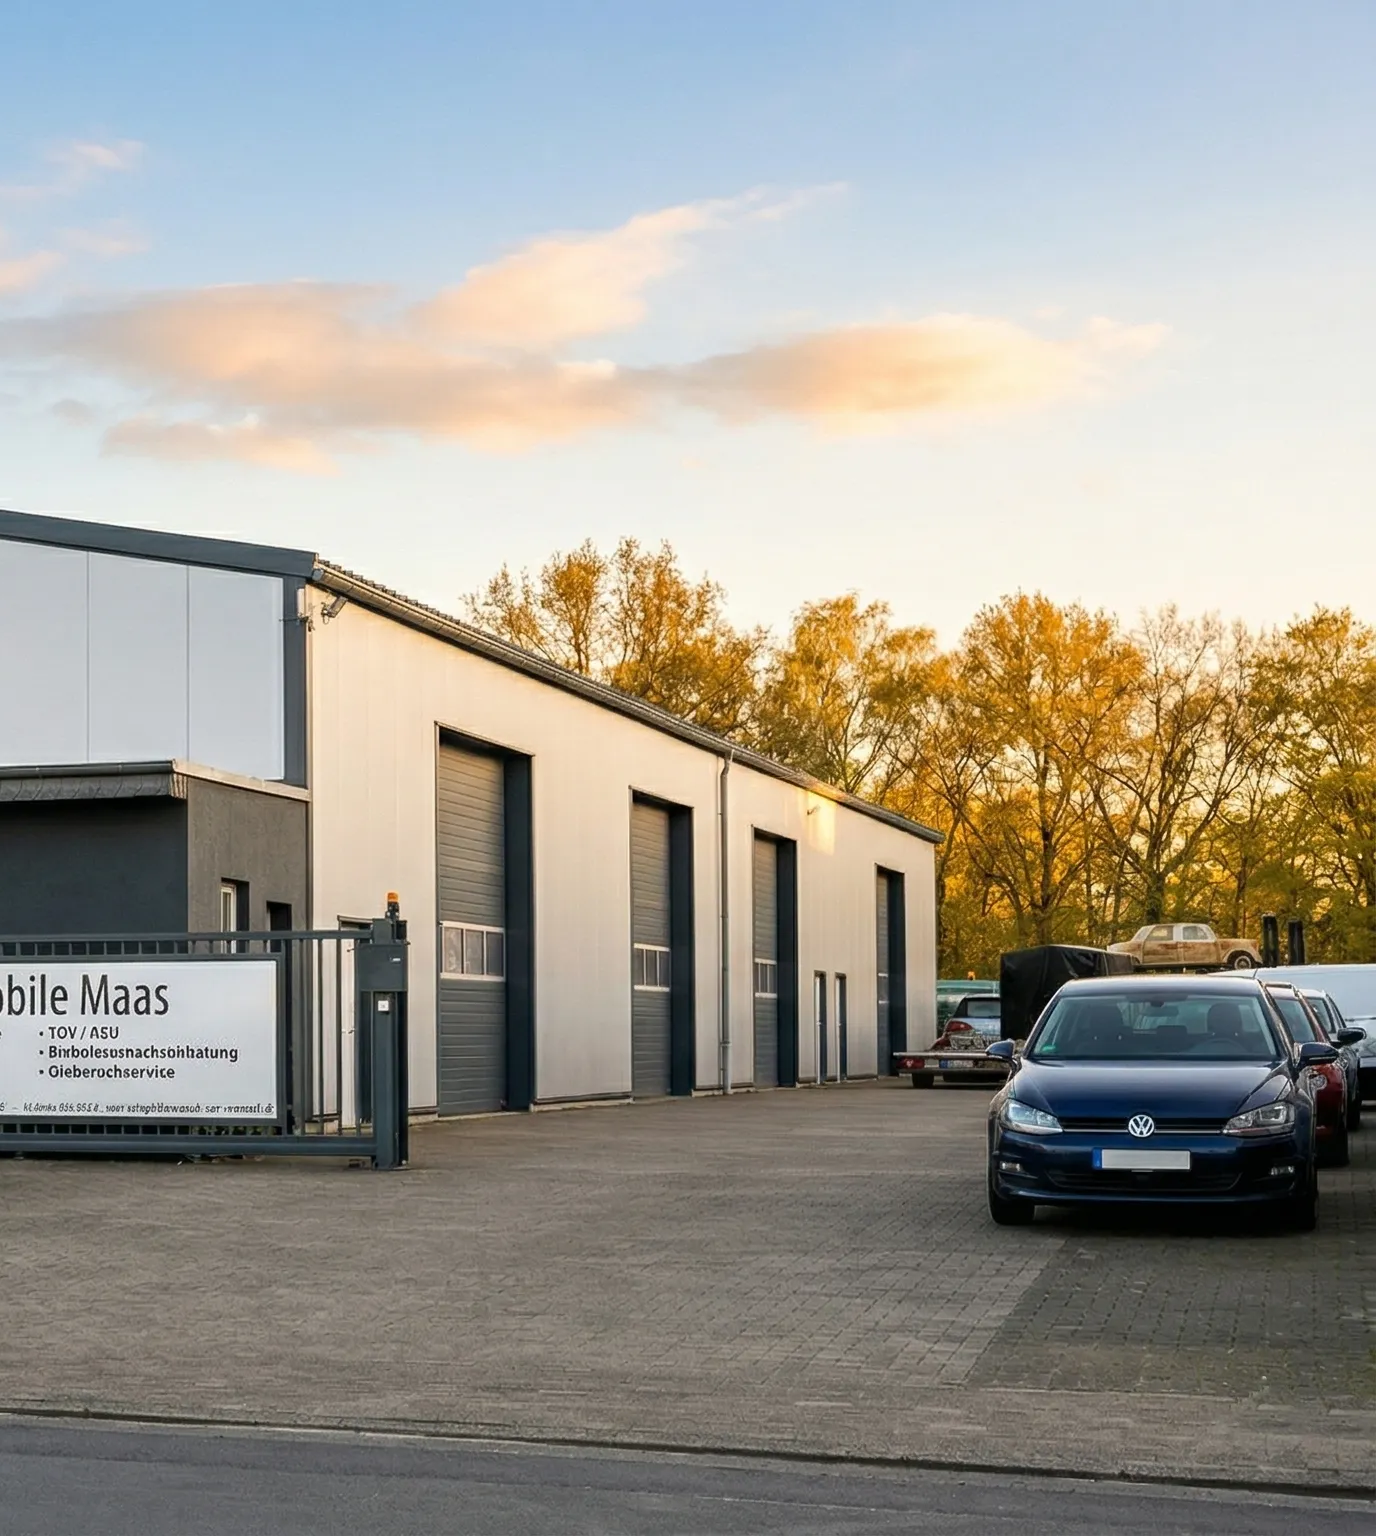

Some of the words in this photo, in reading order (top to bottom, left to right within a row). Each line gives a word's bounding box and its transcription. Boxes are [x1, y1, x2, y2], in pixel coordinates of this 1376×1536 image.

[80, 974, 170, 1017] Maas
[90, 1026, 119, 1039] ASU
[1128, 1114, 1154, 1138] VW
